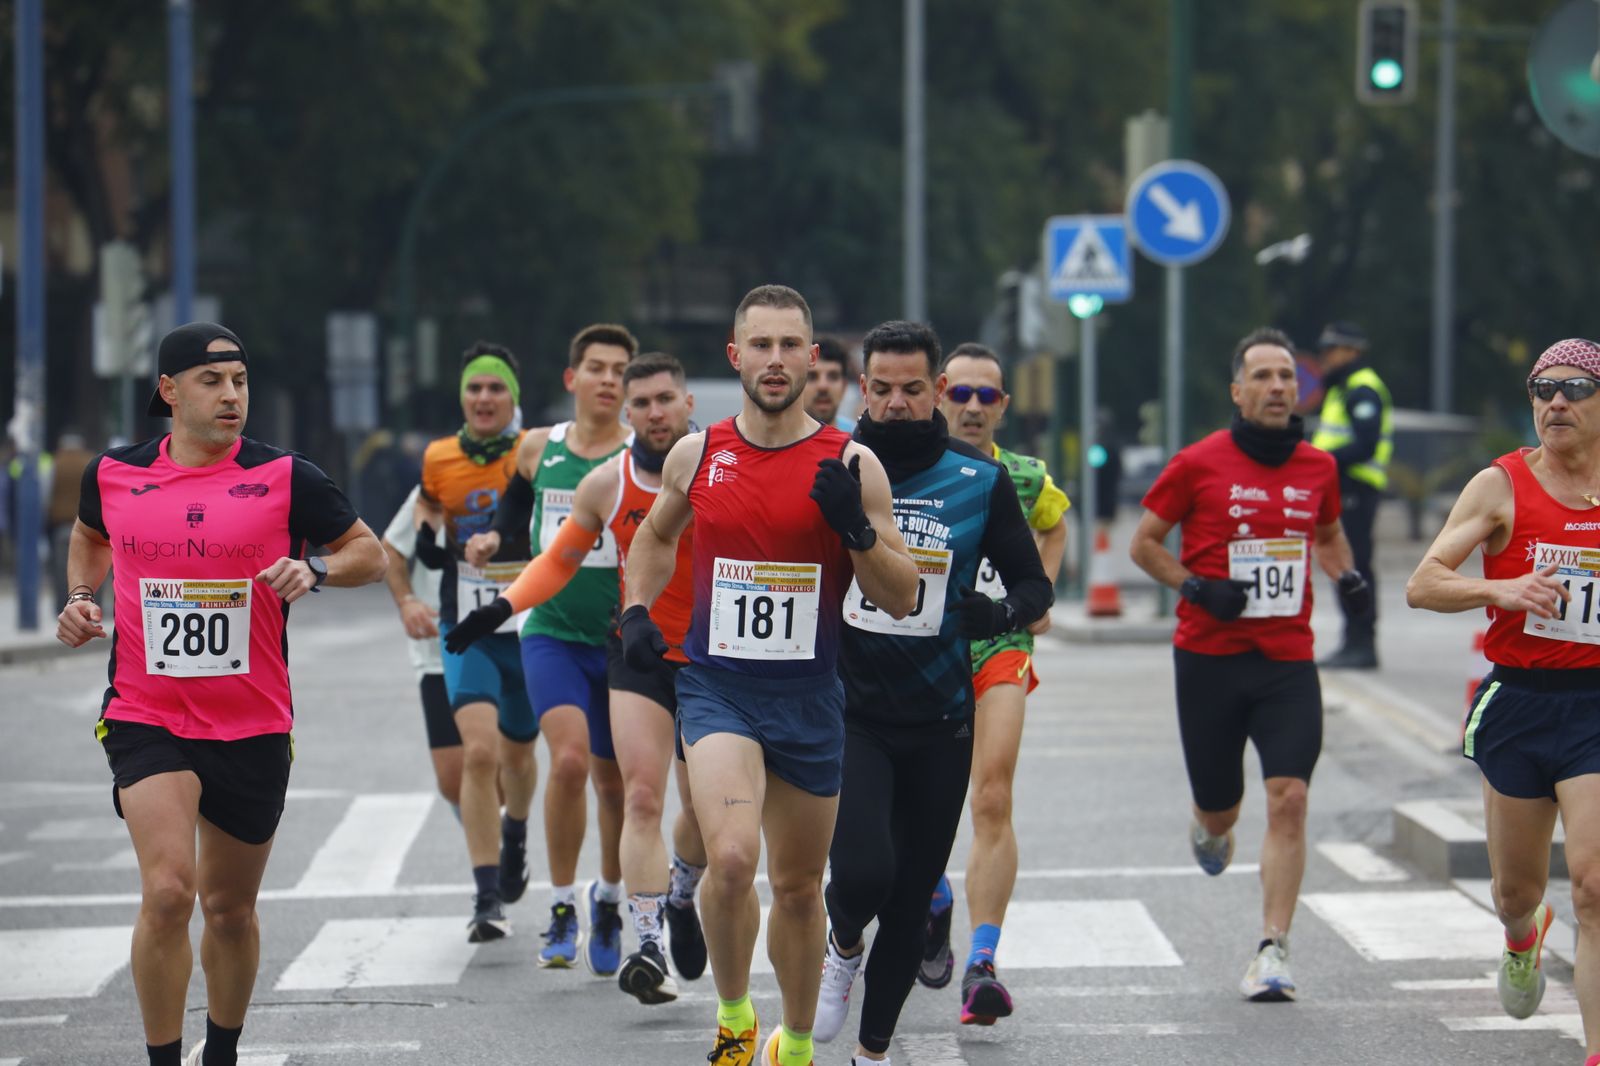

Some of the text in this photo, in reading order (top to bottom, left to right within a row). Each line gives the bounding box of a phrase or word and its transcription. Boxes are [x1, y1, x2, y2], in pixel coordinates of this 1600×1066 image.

[893, 516, 950, 541] A BULUBA
[901, 531, 919, 548] UN
[122, 535, 265, 561] HigarNovias
[1540, 547, 1580, 566] XXXIX
[718, 562, 754, 581] XXXIX
[1251, 565, 1294, 600] 194
[734, 595, 794, 640] 181
[161, 612, 229, 656] 280
